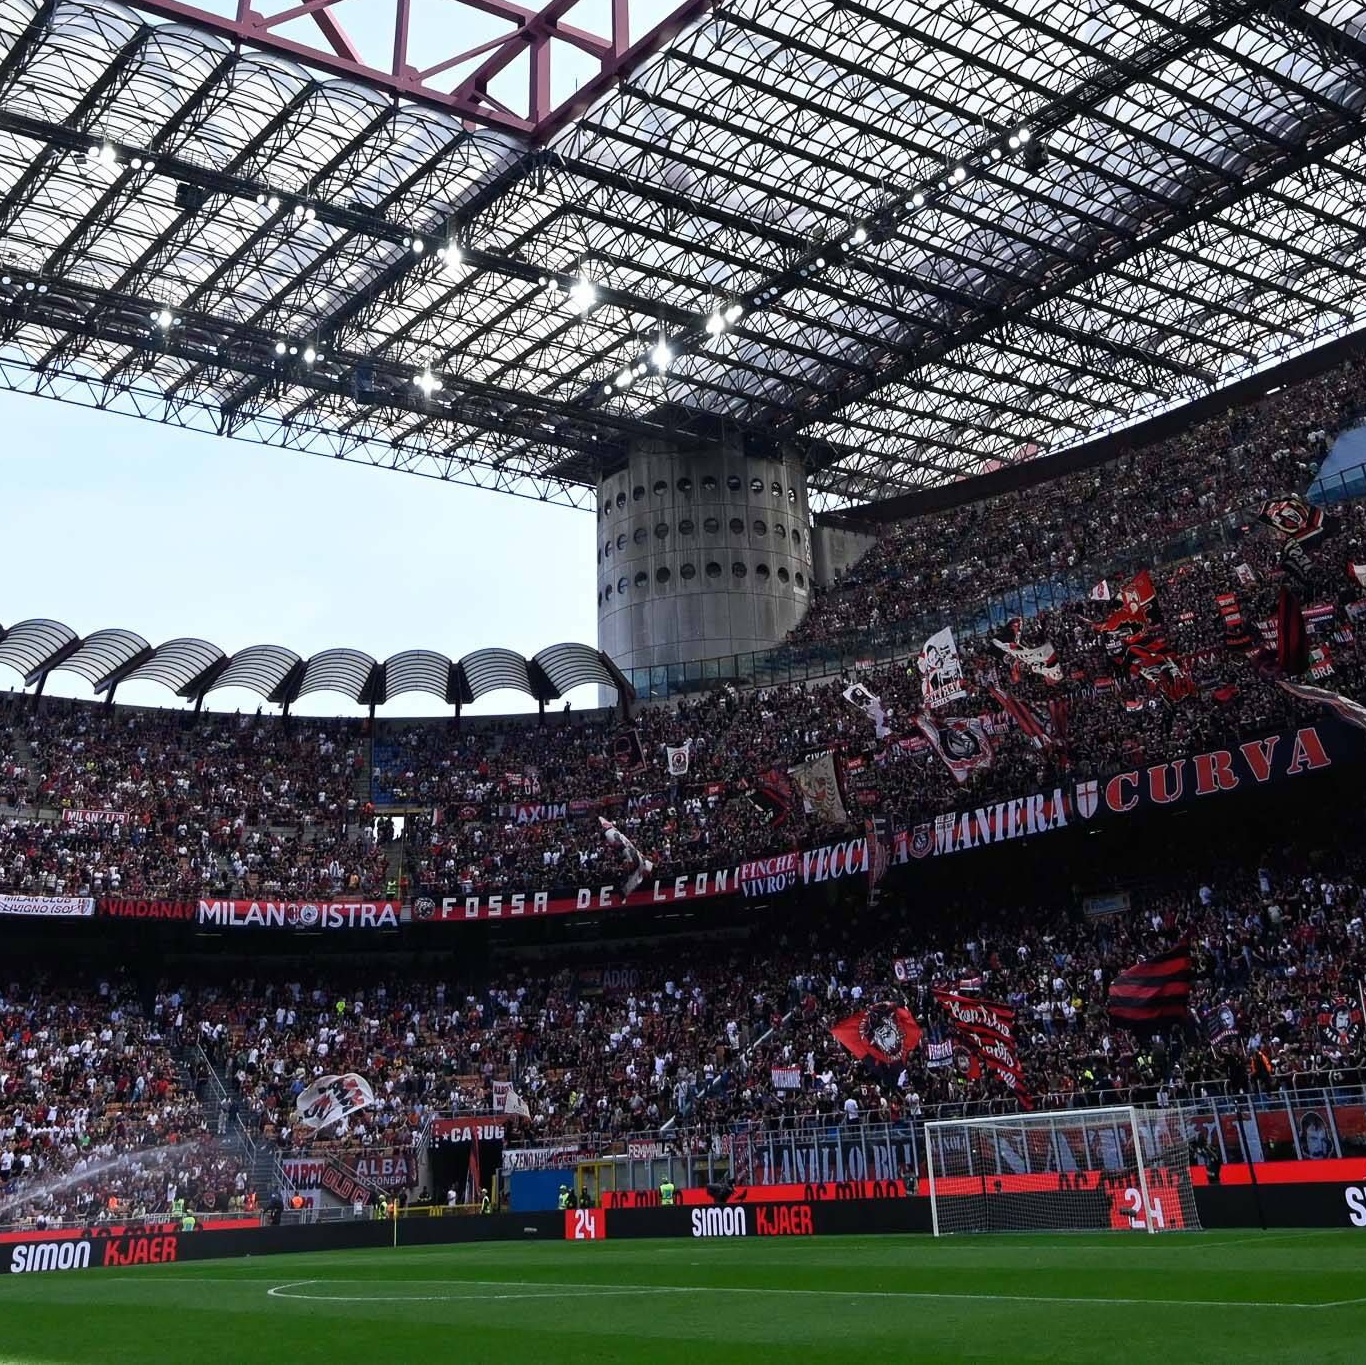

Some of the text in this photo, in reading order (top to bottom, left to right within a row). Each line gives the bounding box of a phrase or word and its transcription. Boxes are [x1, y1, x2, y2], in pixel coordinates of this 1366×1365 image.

[1105, 727, 1332, 812] CURVA
[933, 788, 1068, 857] MANIERA
[3, 904, 49, 914] LIVIGNO
[108, 899, 183, 919] VIADANA
[442, 892, 548, 918] FOSSA
[654, 866, 740, 901] LEONI
[199, 900, 399, 928] MILAN ISTRA
[356, 1158, 408, 1176] ALBA
[575, 1205, 814, 1239] 24 SIMON KJAER
[11, 1241, 91, 1274] SIMON
[103, 1236, 177, 1267] KJAER
